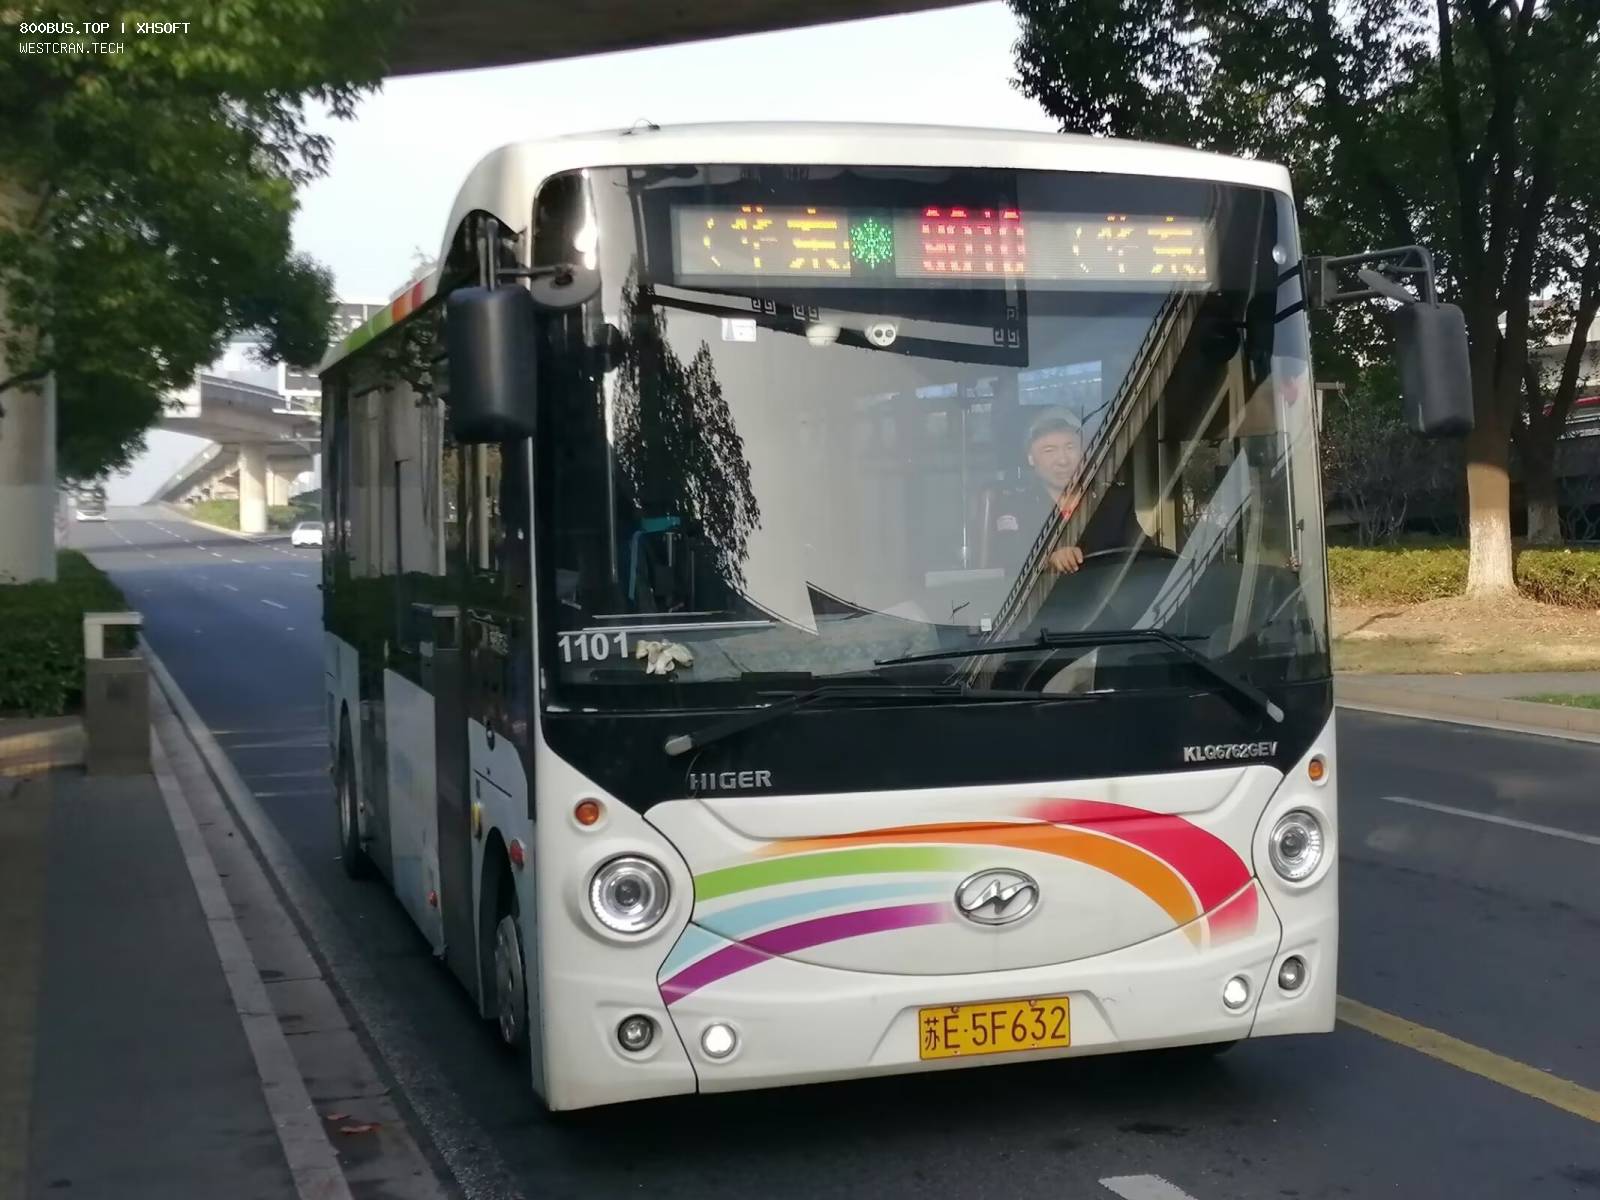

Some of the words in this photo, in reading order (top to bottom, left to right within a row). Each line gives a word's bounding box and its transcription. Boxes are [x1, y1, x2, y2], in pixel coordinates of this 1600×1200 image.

[558, 631, 628, 663] 1101
[1183, 741, 1278, 762] KLQ6762GEV
[690, 770, 772, 790] HIGER
